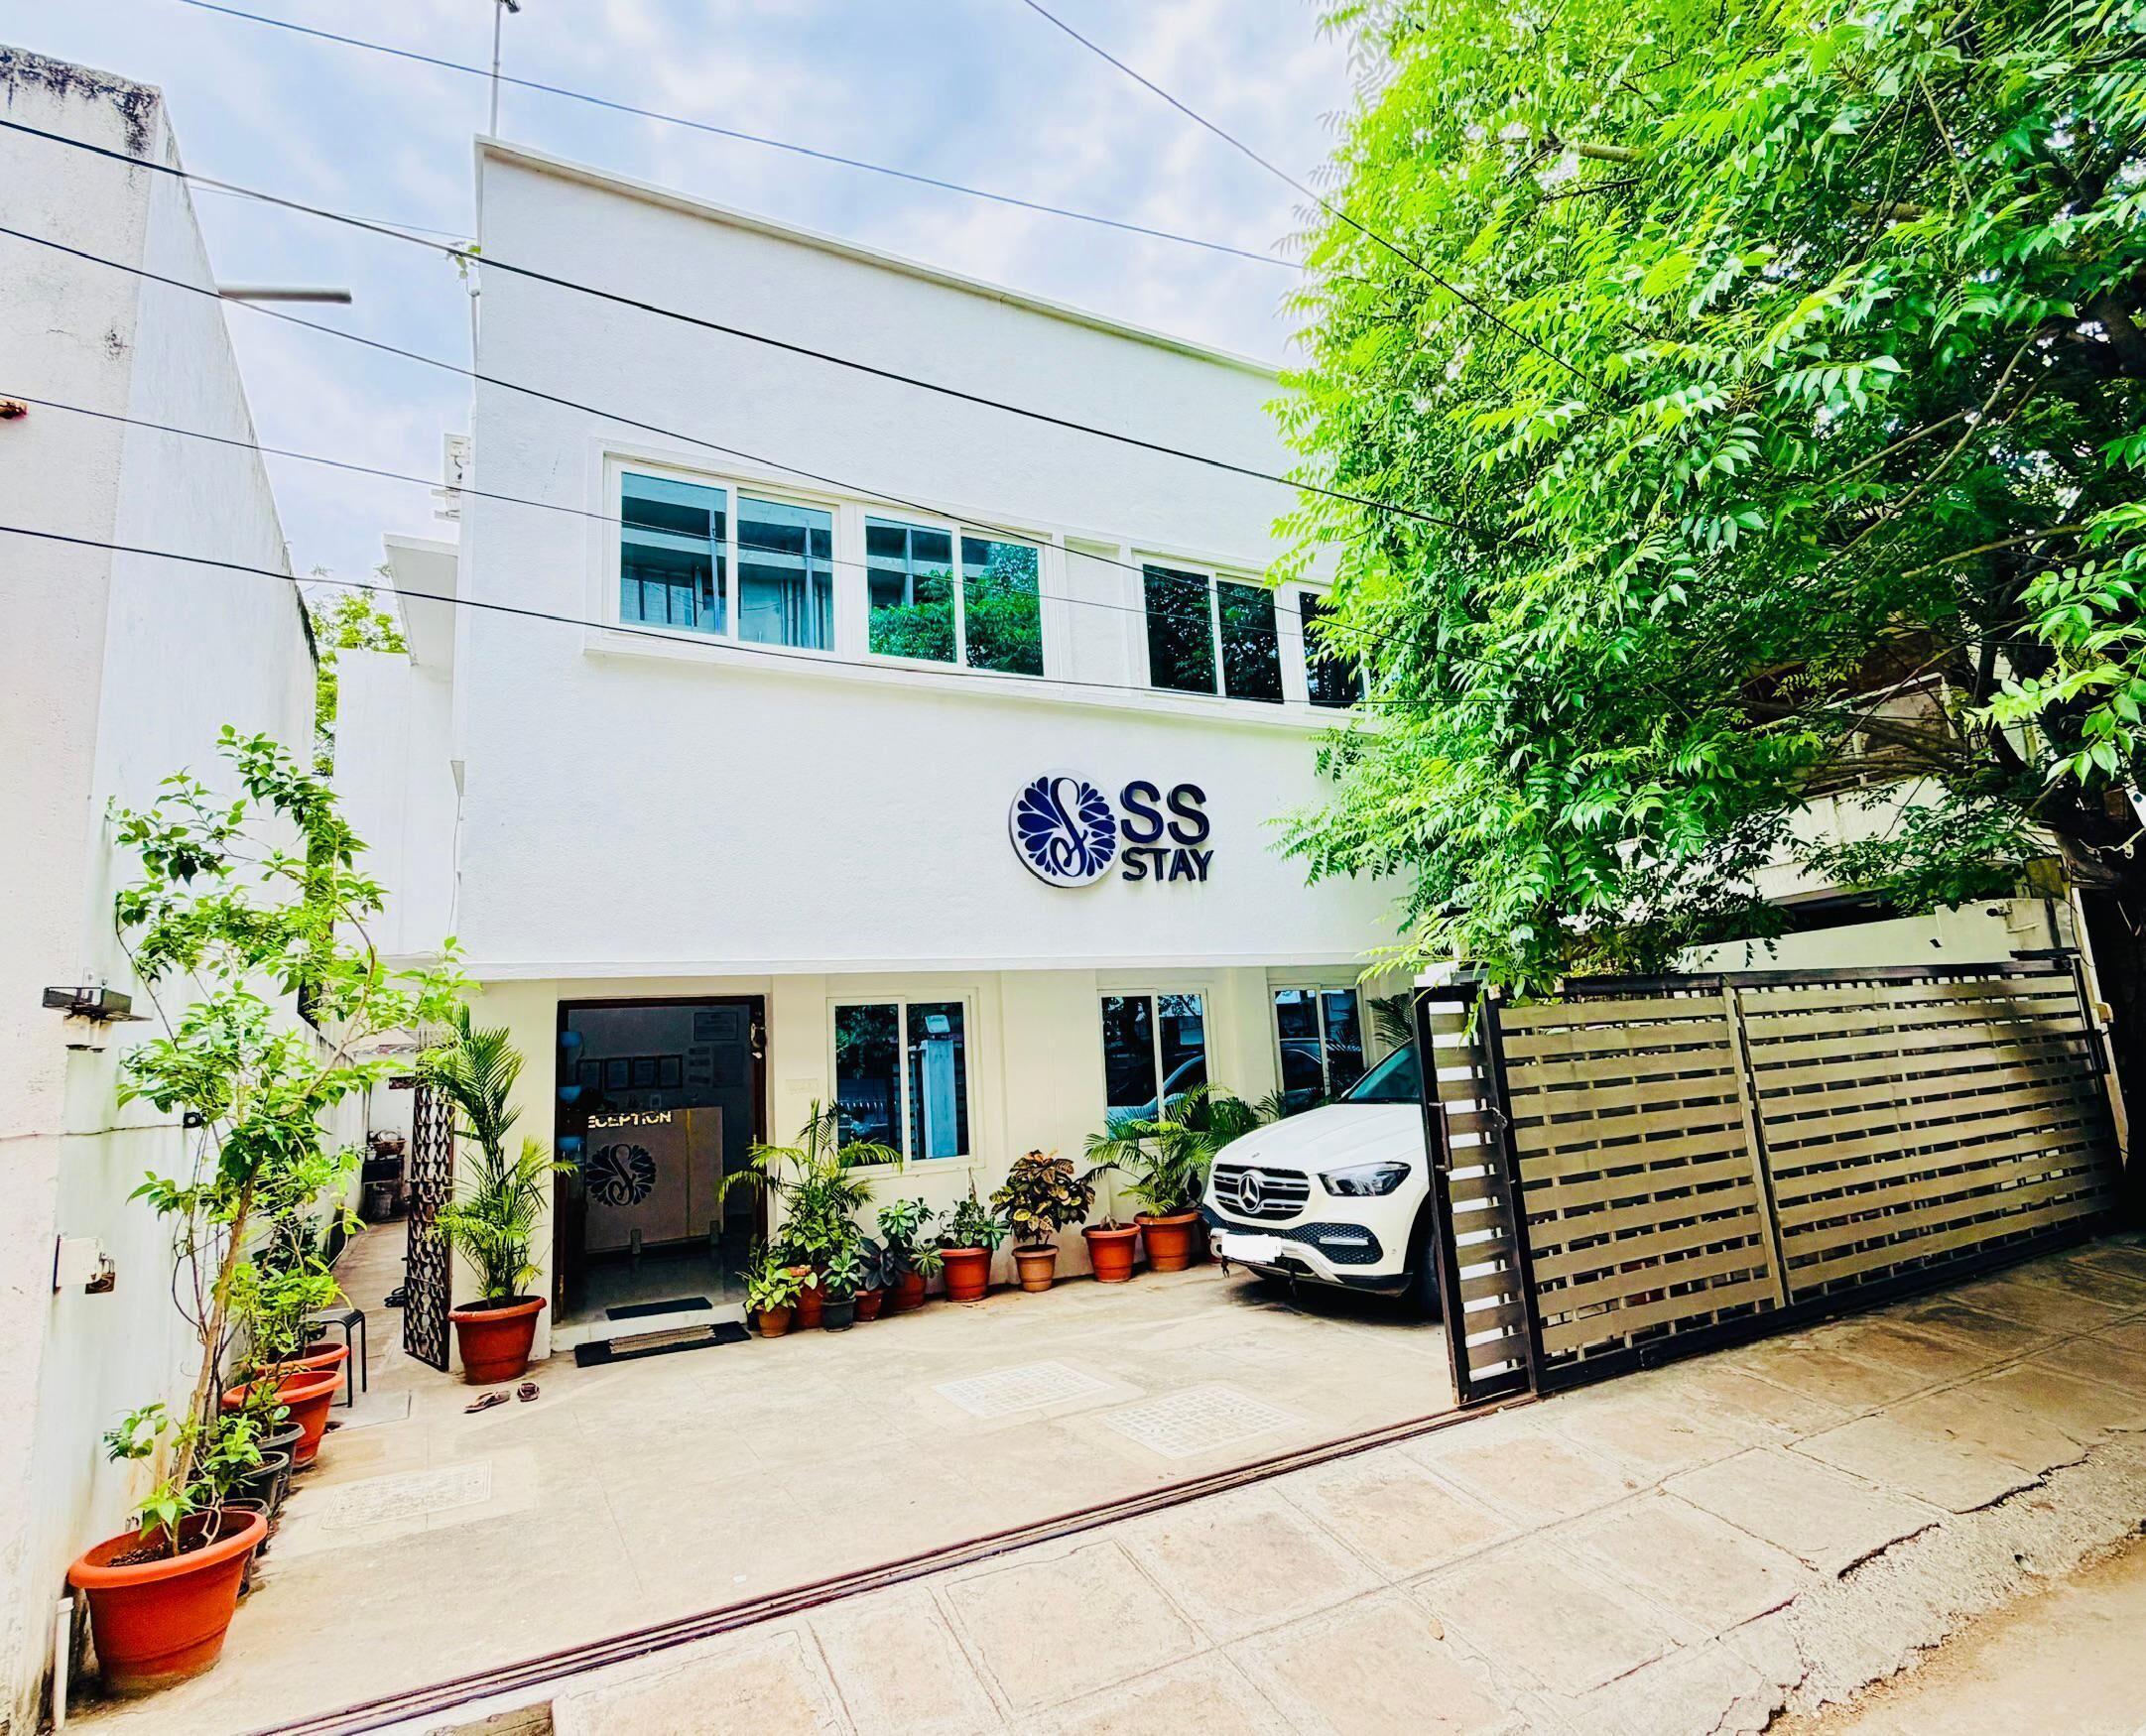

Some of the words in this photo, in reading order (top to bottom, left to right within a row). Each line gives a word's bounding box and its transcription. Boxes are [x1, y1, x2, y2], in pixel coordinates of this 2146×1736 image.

[1120, 781, 1210, 845] SS
[1121, 846, 1214, 882] STAY
[587, 1111, 672, 1128] ECEPTION
